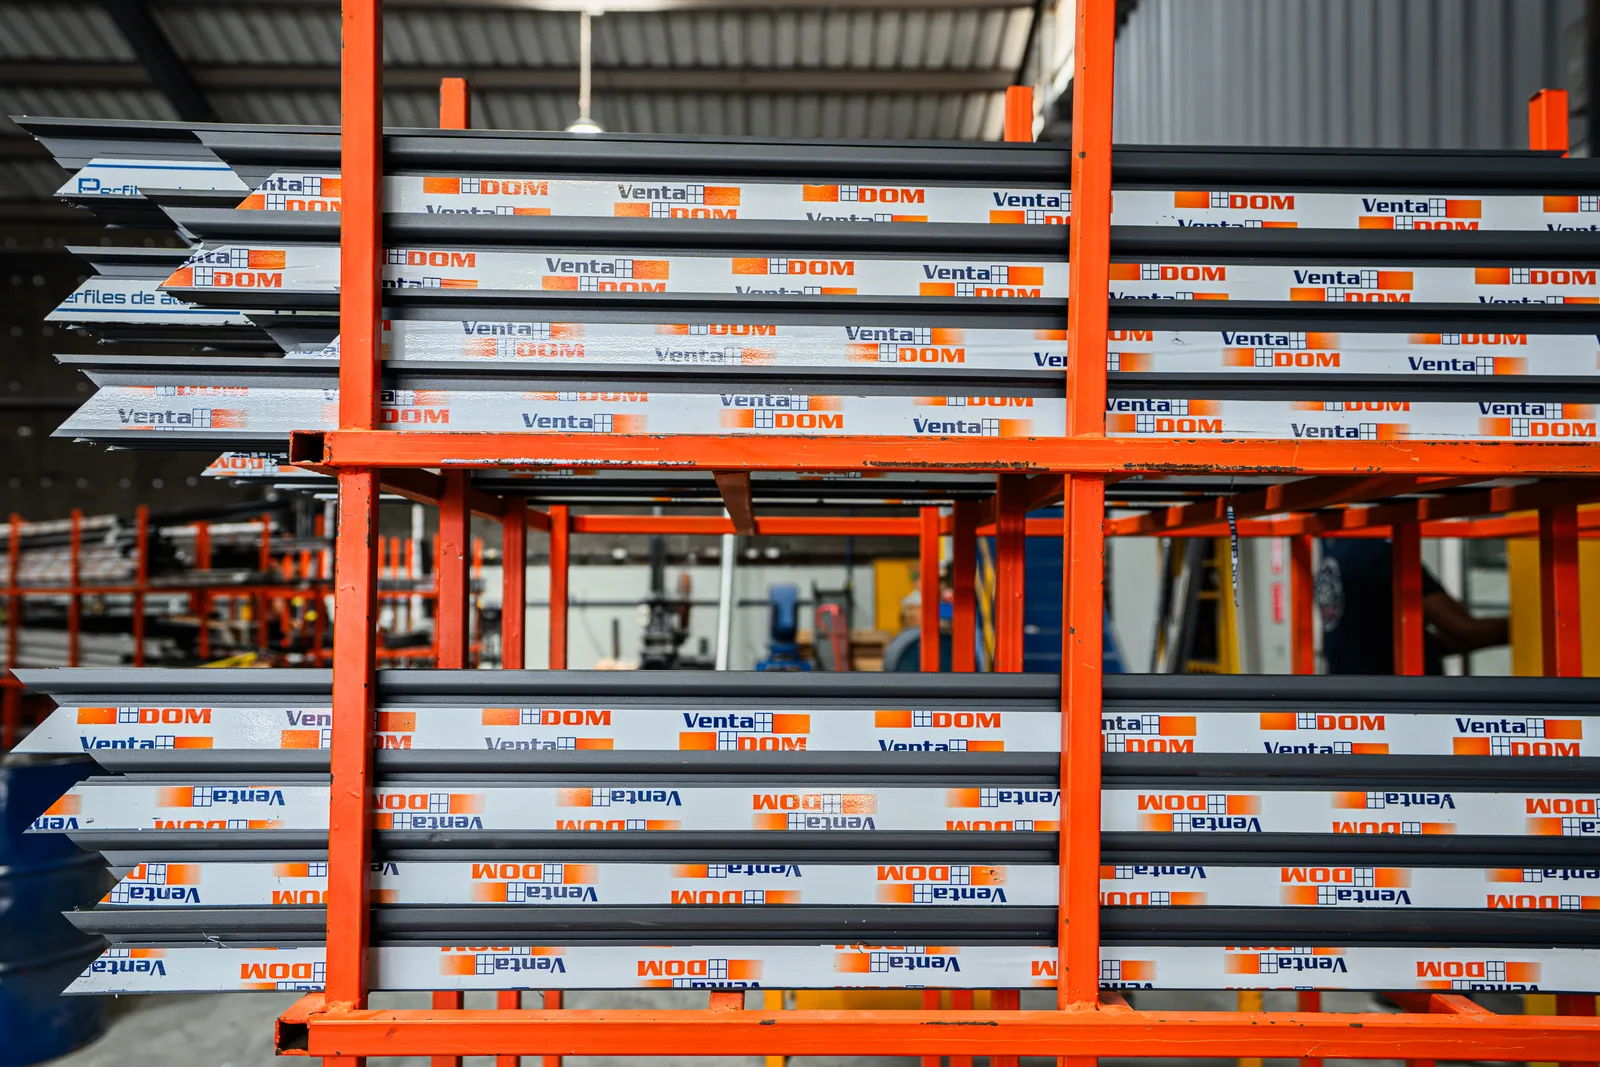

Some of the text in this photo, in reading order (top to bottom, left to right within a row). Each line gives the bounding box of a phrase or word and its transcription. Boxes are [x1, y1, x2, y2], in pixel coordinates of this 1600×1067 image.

[78, 178, 138, 195] Perfil
[256, 177, 302, 192] nta
[480, 180, 549, 196] DOM
[619, 184, 687, 200] Venta
[858, 188, 925, 204] DOM
[993, 192, 1060, 207] Venta
[1229, 194, 1295, 210] DOM
[670, 207, 738, 219] DOM
[1362, 198, 1429, 213] Venta
[1413, 221, 1479, 231] DOM
[1547, 223, 1600, 232] Vent
[407, 250, 476, 268] DOM
[545, 257, 615, 275] Venta
[788, 259, 855, 276] DOM
[923, 264, 990, 281] Venta
[1160, 266, 1226, 281] DOM
[214, 271, 283, 288] DOM
[382, 278, 422, 289] nta
[1294, 269, 1360, 285] Venta
[1530, 270, 1596, 285] DOM
[598, 280, 667, 293] DOM
[975, 287, 1041, 298] DOM
[64, 290, 126, 305] erfiles
[131, 291, 155, 305] de
[1345, 293, 1411, 303] DOM
[462, 320, 532, 336] Venta
[709, 323, 776, 337] DOM
[845, 326, 914, 341] Venta
[1108, 330, 1153, 341] OM
[1222, 331, 1289, 346] Venta
[1461, 333, 1527, 345] DOM
[516, 342, 585, 358] DOM
[899, 348, 965, 364] DOM
[1274, 352, 1340, 367] DOM
[1408, 356, 1476, 371] Venta
[720, 393, 790, 407] Venta
[967, 396, 1034, 407] DOM
[1344, 401, 1410, 412] DOM
[118, 408, 191, 424] Venta
[381, 408, 449, 424] DOM
[1478, 402, 1544, 415] Venta
[522, 413, 593, 429] Venta
[774, 413, 843, 429] DOM
[913, 418, 981, 434] Venta
[1156, 418, 1222, 433] DOM
[1291, 423, 1359, 438] Venta
[1530, 422, 1597, 437] DOM
[140, 708, 212, 724] DOM
[286, 710, 331, 726] Ven
[541, 710, 611, 726] DOM
[683, 713, 753, 728] Venta
[932, 713, 1001, 728] DOM
[1101, 716, 1141, 731] nta
[1317, 715, 1385, 730] DOM
[1456, 718, 1526, 733] Venta
[80, 736, 154, 749] Venta
[485, 737, 556, 750] Venta
[738, 737, 807, 750] DOM
[878, 740, 948, 751] Venta
[1126, 739, 1194, 752] DOM
[1263, 742, 1333, 754] Venta
[1511, 742, 1580, 756] DOM
[213, 790, 285, 806] Venta
[611, 790, 682, 806] Venta
[752, 794, 822, 810] DOM
[1138, 795, 1206, 810] DOM
[1385, 792, 1456, 809] Venta
[1526, 798, 1595, 814] DOM
[32, 817, 79, 830] Ven
[155, 820, 226, 829] DOM
[413, 816, 484, 829] Venta
[556, 820, 625, 830] DOM
[806, 816, 875, 830] Venta
[946, 821, 1013, 830] DOM
[1192, 816, 1262, 832] Venta
[1332, 821, 1401, 833] DOM
[471, 864, 542, 880] DOM
[727, 865, 802, 877] Venta
[877, 866, 949, 881] DOM
[1134, 867, 1207, 879] Venta
[1281, 868, 1353, 883] DOM
[1543, 869, 1600, 880] enta
[130, 887, 201, 903] Venta
[526, 886, 598, 902] Venta
[671, 890, 743, 904] DOM
[933, 887, 1007, 903] Venta
[1100, 892, 1149, 905] DO
[1337, 889, 1412, 905] Venta
[1487, 894, 1559, 909] DOM
[92, 959, 167, 976] Venta
[241, 963, 312, 979] DOM
[495, 957, 566, 973] Venta
[637, 959, 707, 976] DOM
[889, 956, 961, 972] Venta
[1278, 957, 1348, 973] Venta
[1416, 961, 1485, 977] DOM
